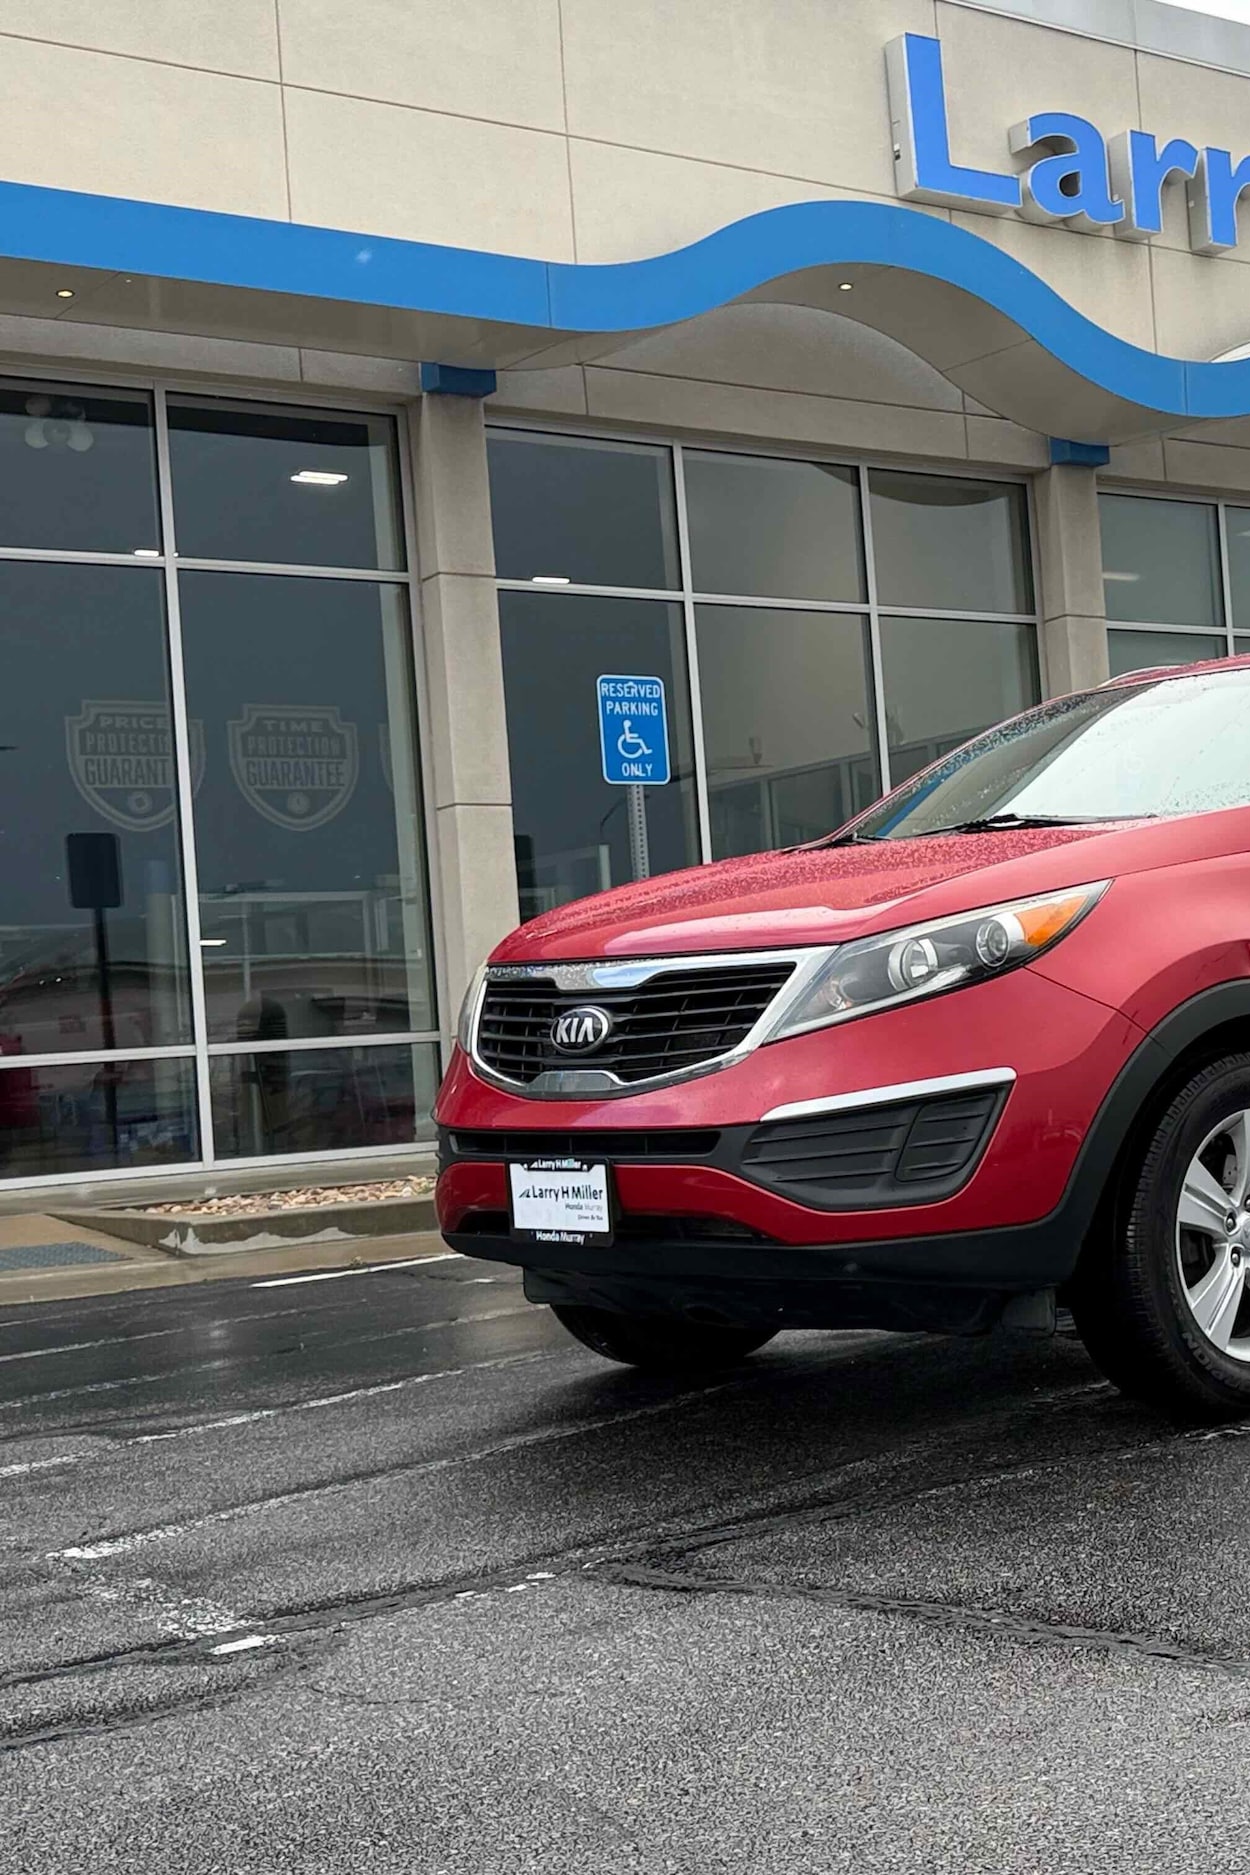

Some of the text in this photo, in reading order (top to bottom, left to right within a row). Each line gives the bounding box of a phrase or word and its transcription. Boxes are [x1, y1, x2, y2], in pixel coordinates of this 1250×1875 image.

[601, 682, 661, 699] RESERVED
[606, 701, 659, 716] PARKING
[99, 715, 170, 728] PRICE
[262, 720, 324, 733] TIME
[247, 735, 342, 756] PROTECTION
[84, 757, 170, 786] GUARANT
[246, 759, 345, 787] GUARANTEE
[621, 763, 653, 777] ONLY
[556, 1017, 595, 1043] KIA
[539, 1159, 555, 1171] Larry
[562, 1159, 581, 1169] Miller
[532, 1184, 603, 1203] Larry H Miller
[536, 1230, 585, 1246] Honda Murray
